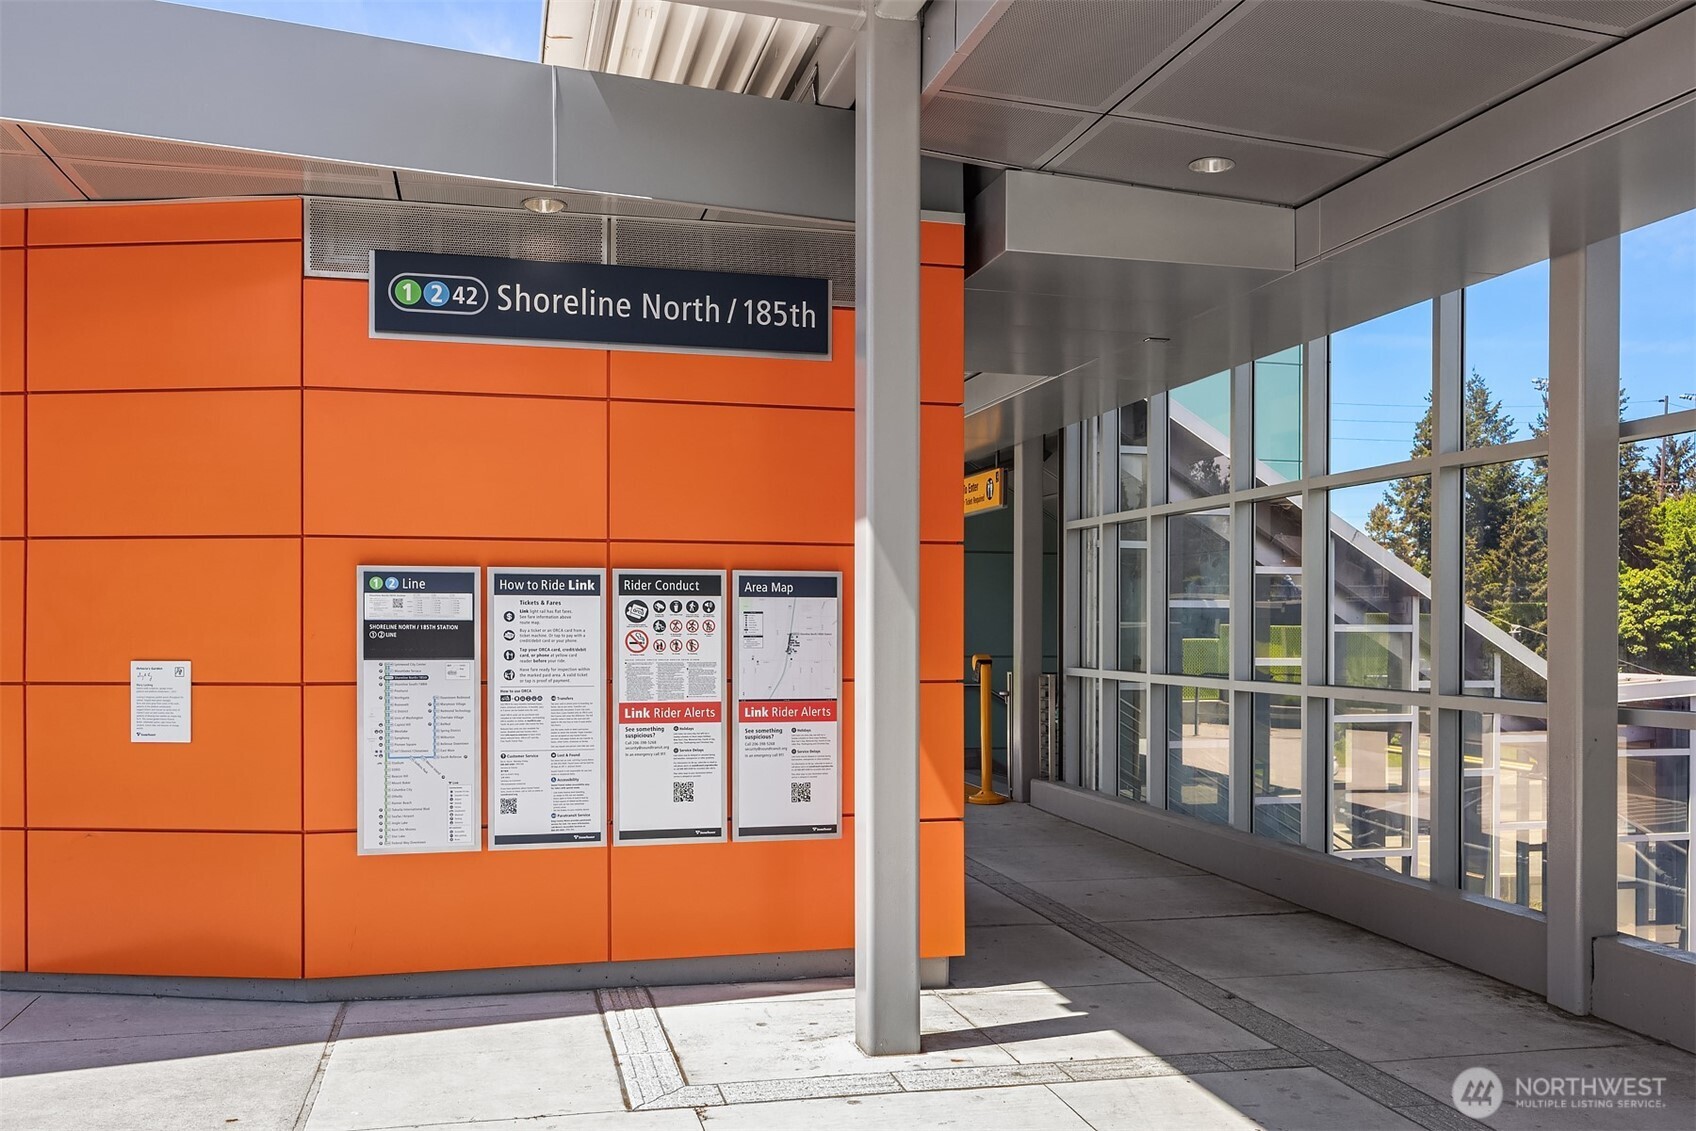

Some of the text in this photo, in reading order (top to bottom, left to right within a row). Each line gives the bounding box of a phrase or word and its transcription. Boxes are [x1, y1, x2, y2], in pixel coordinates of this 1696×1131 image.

[403, 284, 816, 328] 1 2 42 Shoreline North / 185th
[373, 578, 425, 589] 1 2 Line
[500, 580, 595, 590] How to Ride Link
[624, 580, 699, 591] Rider Conduct
[744, 582, 793, 595] Area Map
[625, 707, 715, 718] Link Rider Alerts
[745, 706, 831, 717] Link Rider Alerts
